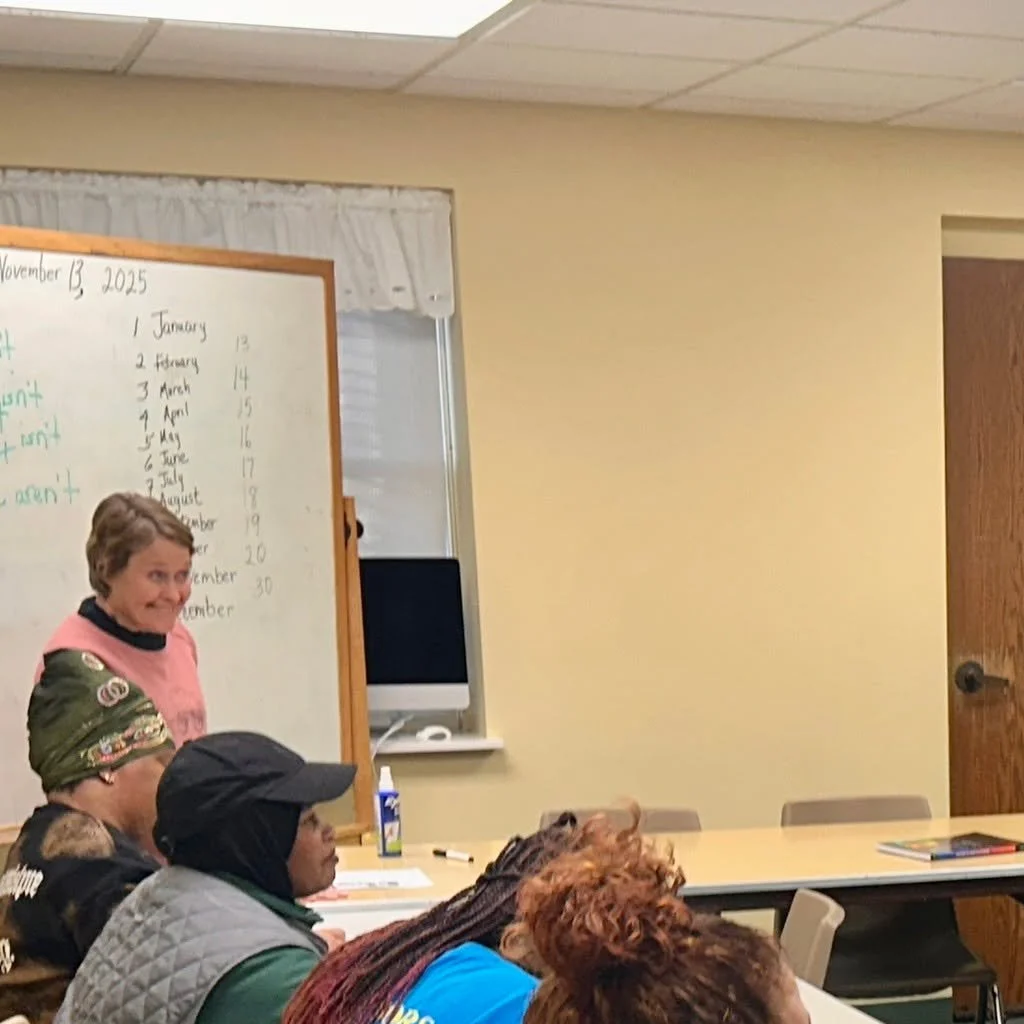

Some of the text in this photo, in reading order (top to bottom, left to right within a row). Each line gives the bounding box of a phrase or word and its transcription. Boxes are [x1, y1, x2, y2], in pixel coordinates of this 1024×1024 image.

[102, 265, 148, 295] 2025
[151, 309, 207, 343] January
[136, 352, 146, 369] 2
[233, 364, 249, 391] 14
[137, 380, 149, 402] 3
[163, 400, 189, 427] April
[159, 428, 181, 451] May
[240, 423, 252, 449] 16
[143, 449, 189, 472] 6 June
[242, 455, 255, 480] 17
[158, 467, 185, 493] July
[244, 542, 267, 566] 20
